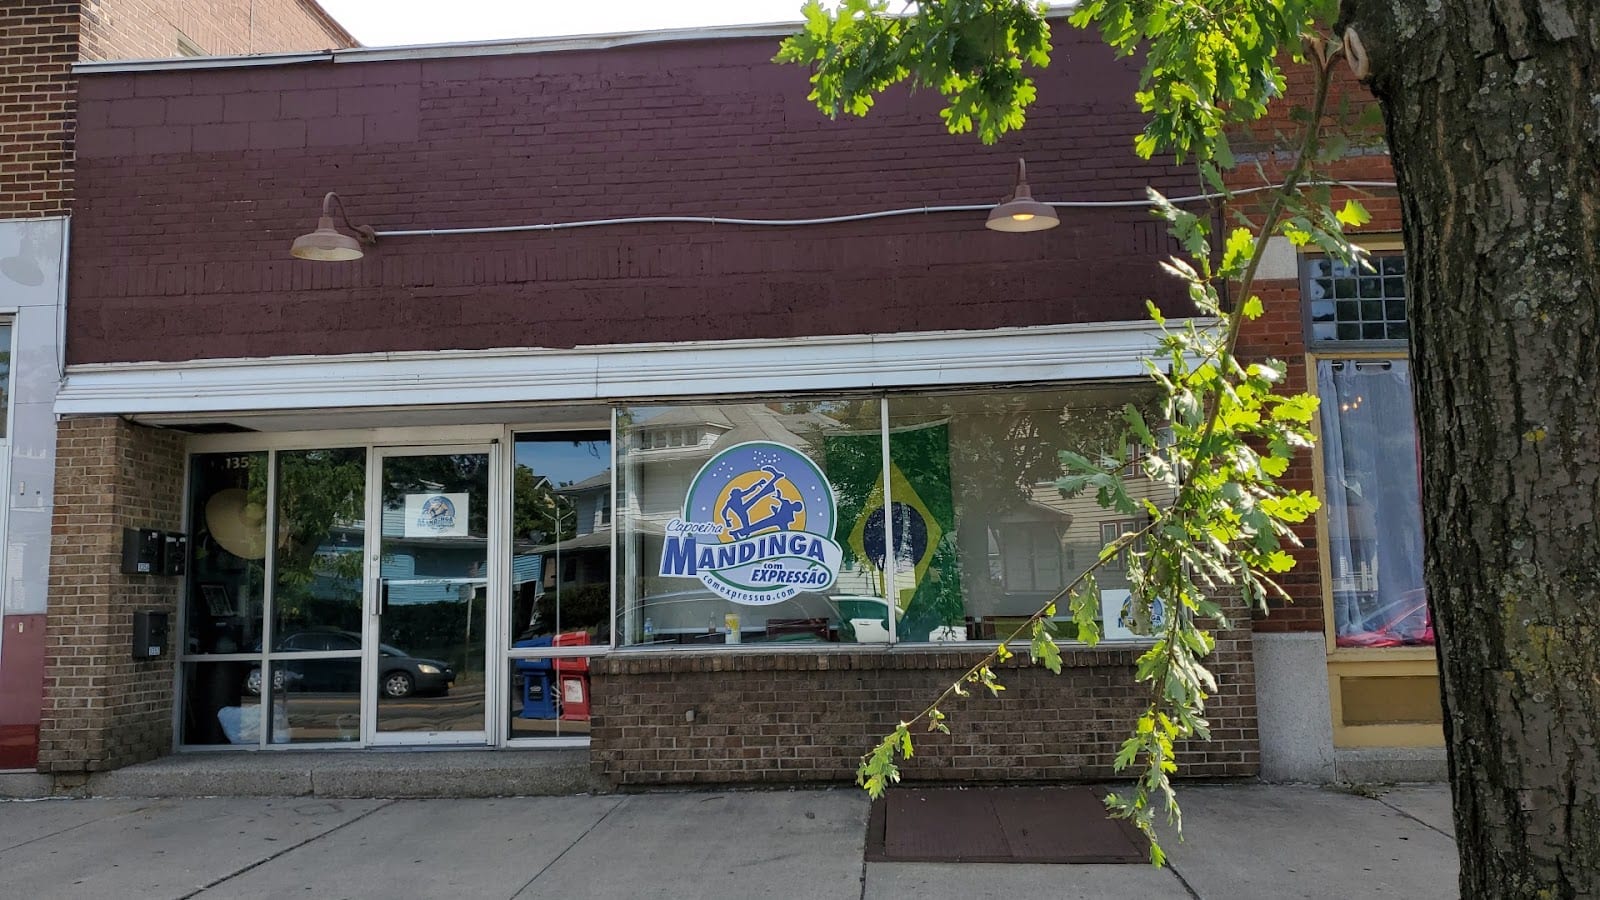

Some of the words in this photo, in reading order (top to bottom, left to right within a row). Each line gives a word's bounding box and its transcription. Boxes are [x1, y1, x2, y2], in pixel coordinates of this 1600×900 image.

[666, 519, 723, 534] Capoeira
[661, 534, 826, 576] MANDINGA
[763, 562, 783, 570] com
[751, 568, 828, 585] EXPRESSÃO
